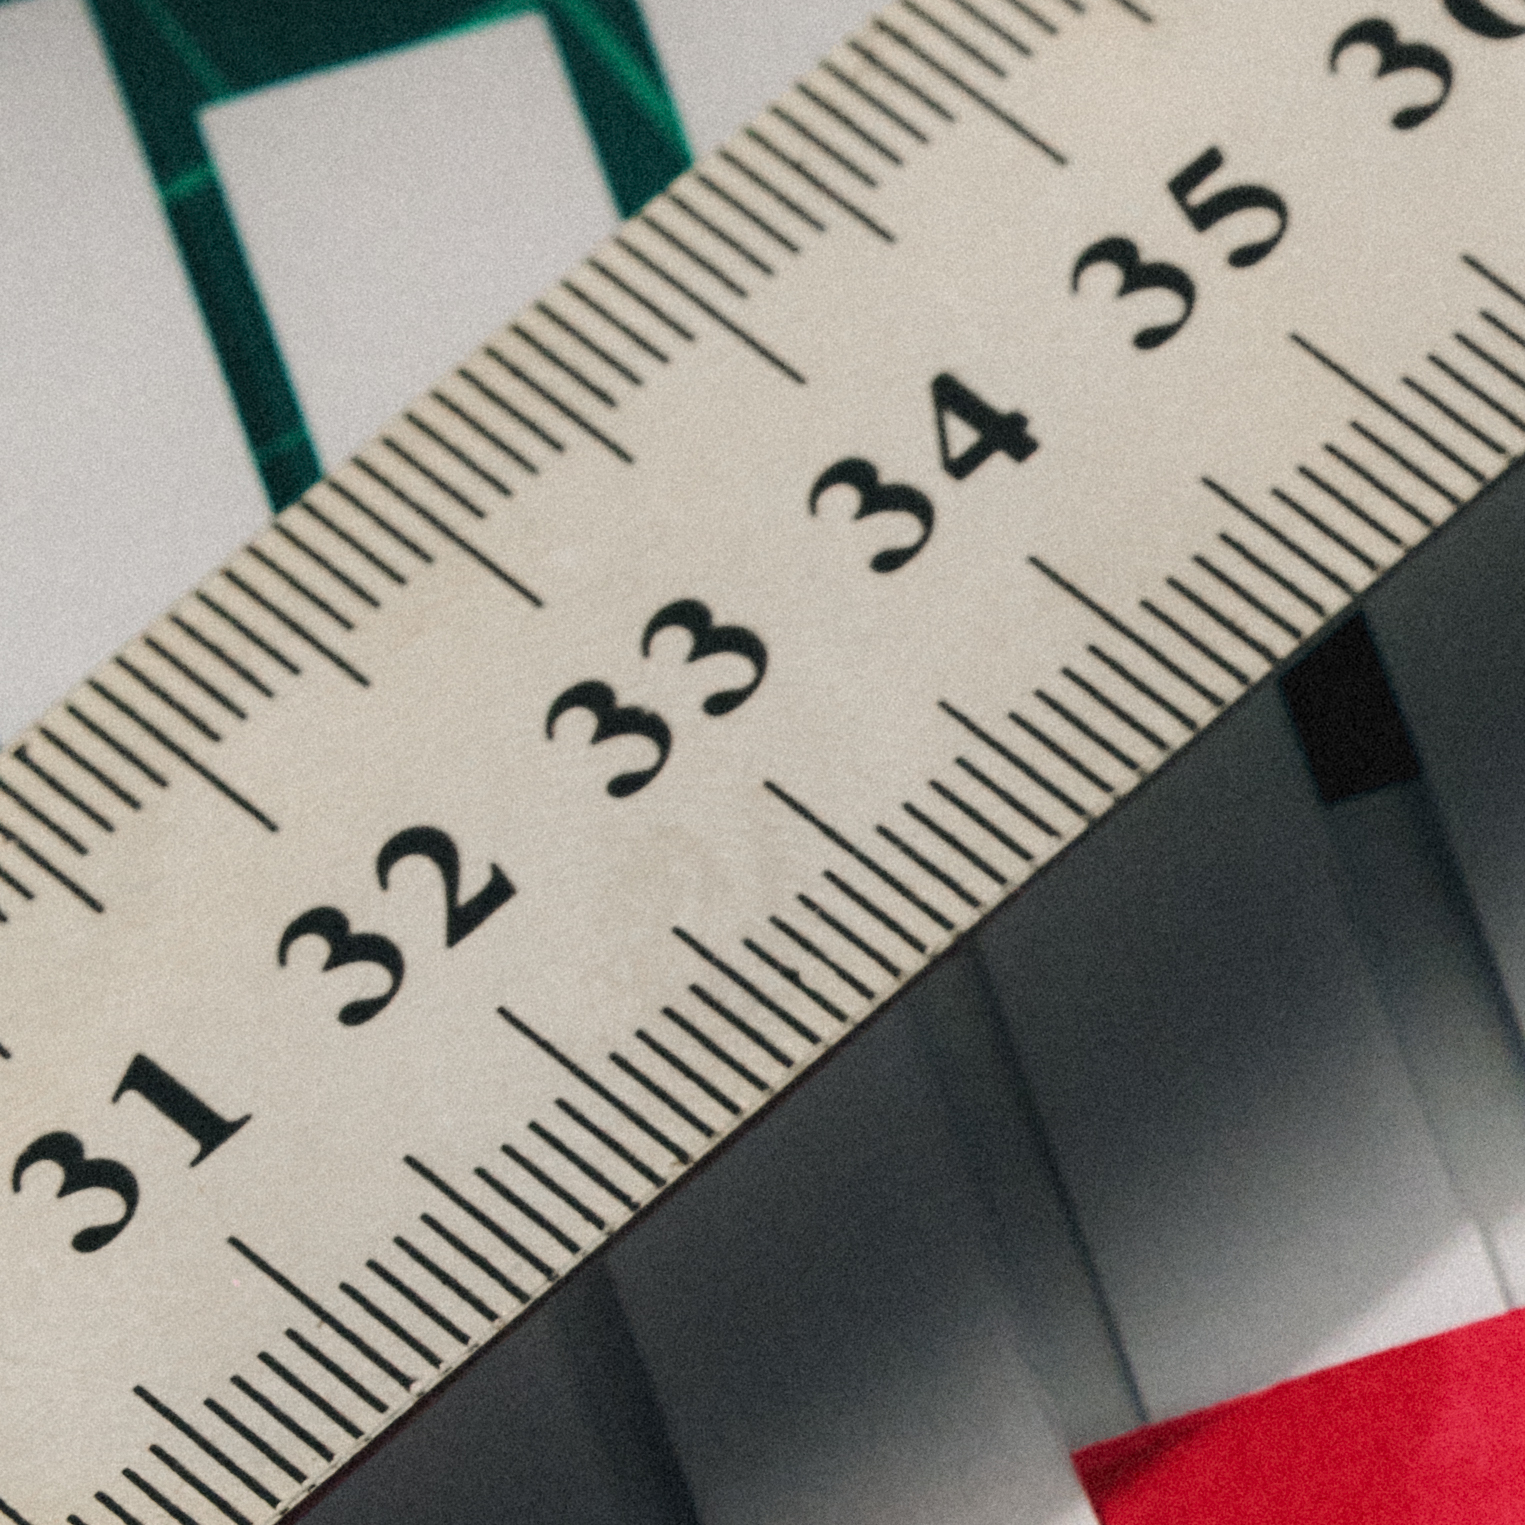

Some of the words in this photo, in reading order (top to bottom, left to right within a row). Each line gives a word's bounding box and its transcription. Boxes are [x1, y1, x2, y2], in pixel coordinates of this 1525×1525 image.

[12, 1052, 252, 1253] 31
[278, 825, 517, 1026] 32
[545, 598, 769, 799] 33
[808, 372, 1040, 574] 34
[1069, 146, 1289, 351] 35
